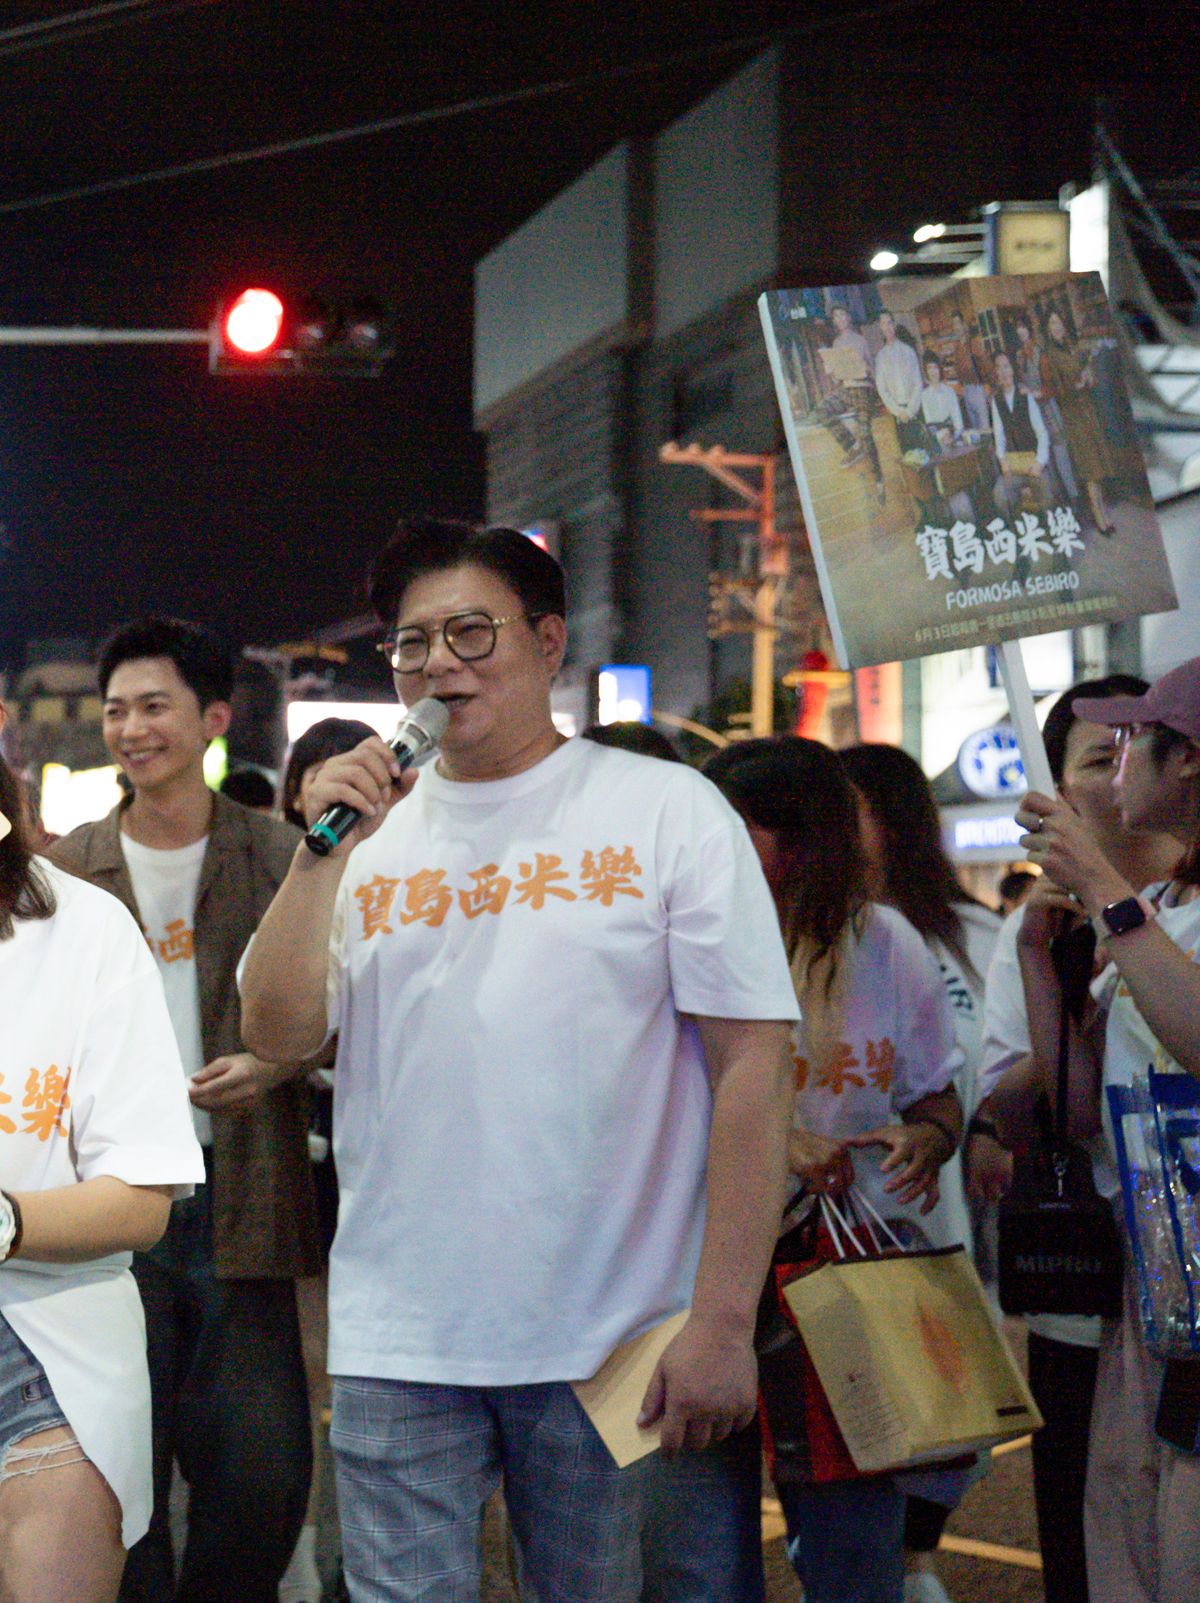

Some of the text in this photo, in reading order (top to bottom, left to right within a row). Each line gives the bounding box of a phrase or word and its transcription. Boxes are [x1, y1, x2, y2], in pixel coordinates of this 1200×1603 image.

[915, 506, 1086, 580] 寶島西米樂
[946, 570, 1081, 610] FORMOSA SEBIRO
[353, 845, 645, 942] 寶島西米樂
